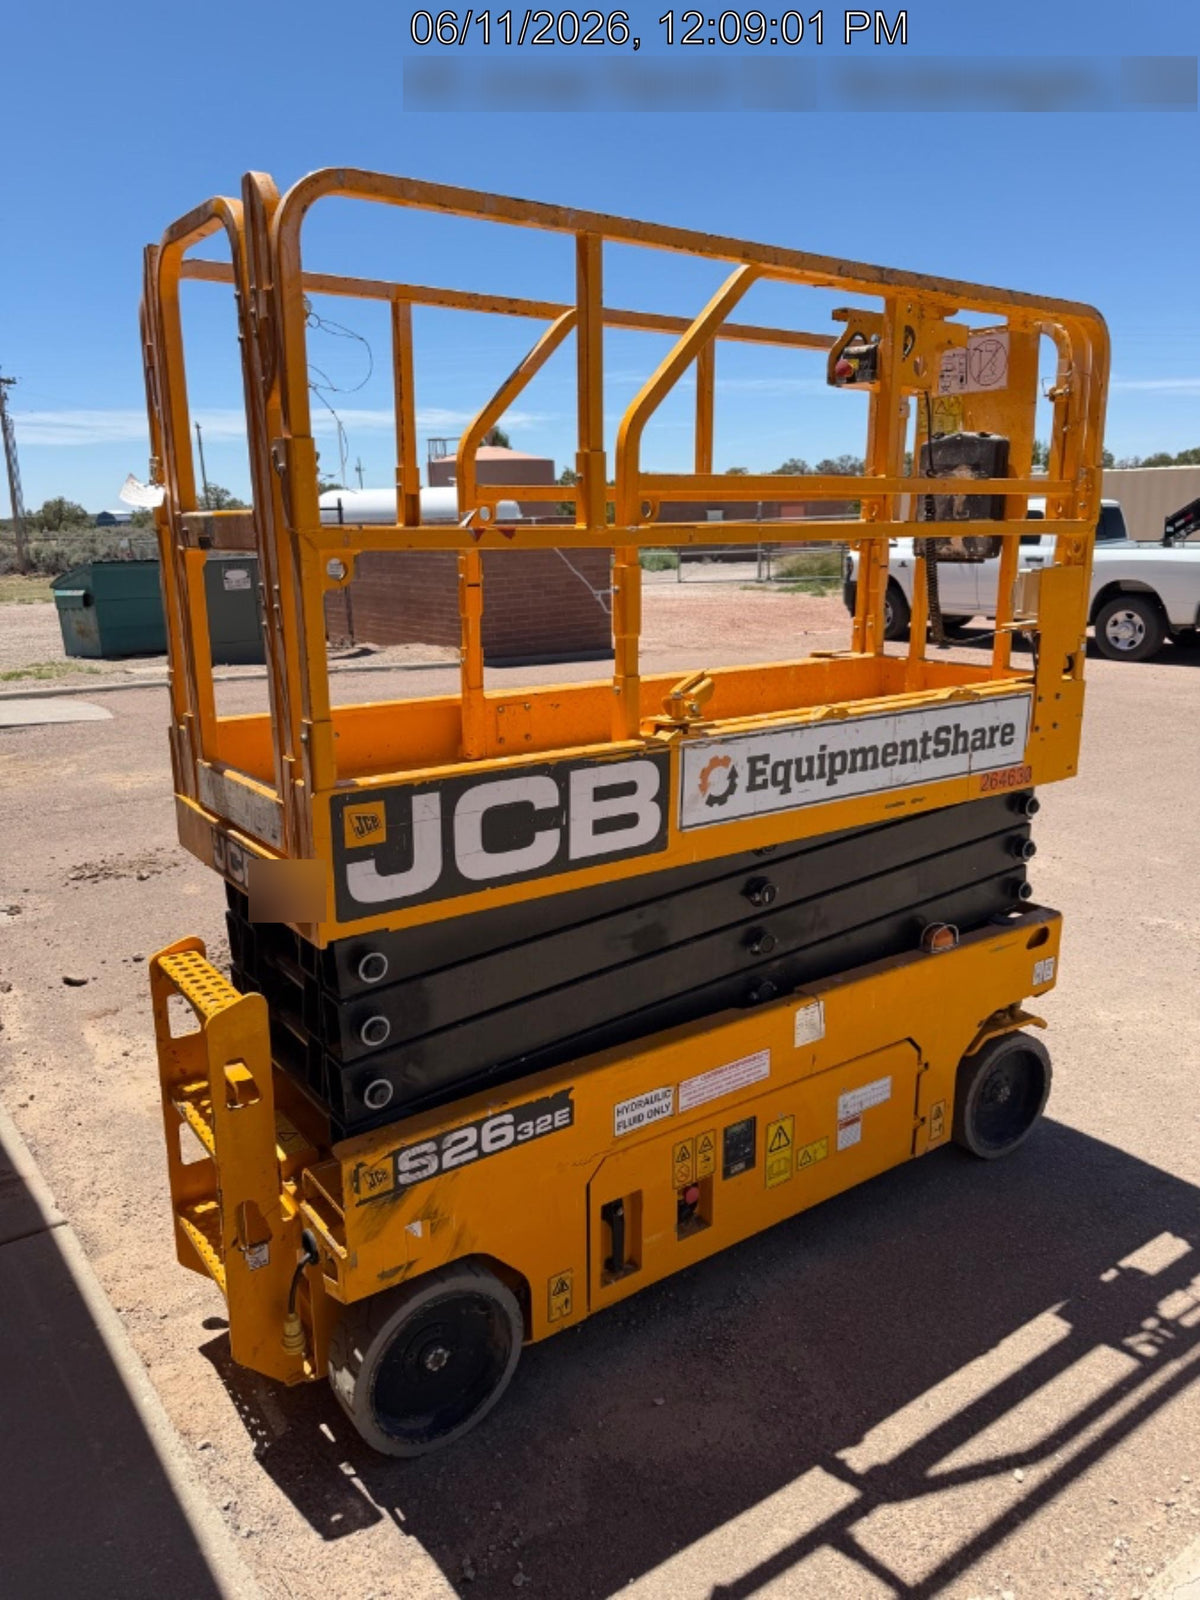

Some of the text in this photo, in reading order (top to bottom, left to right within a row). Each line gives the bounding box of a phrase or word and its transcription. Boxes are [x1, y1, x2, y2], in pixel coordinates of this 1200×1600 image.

[745, 720, 1015, 795] EquipmentShare
[346, 760, 661, 903] JCB
[616, 1089, 671, 1117] HYDRAULIC
[616, 1102, 671, 1131] FLUID ONLY
